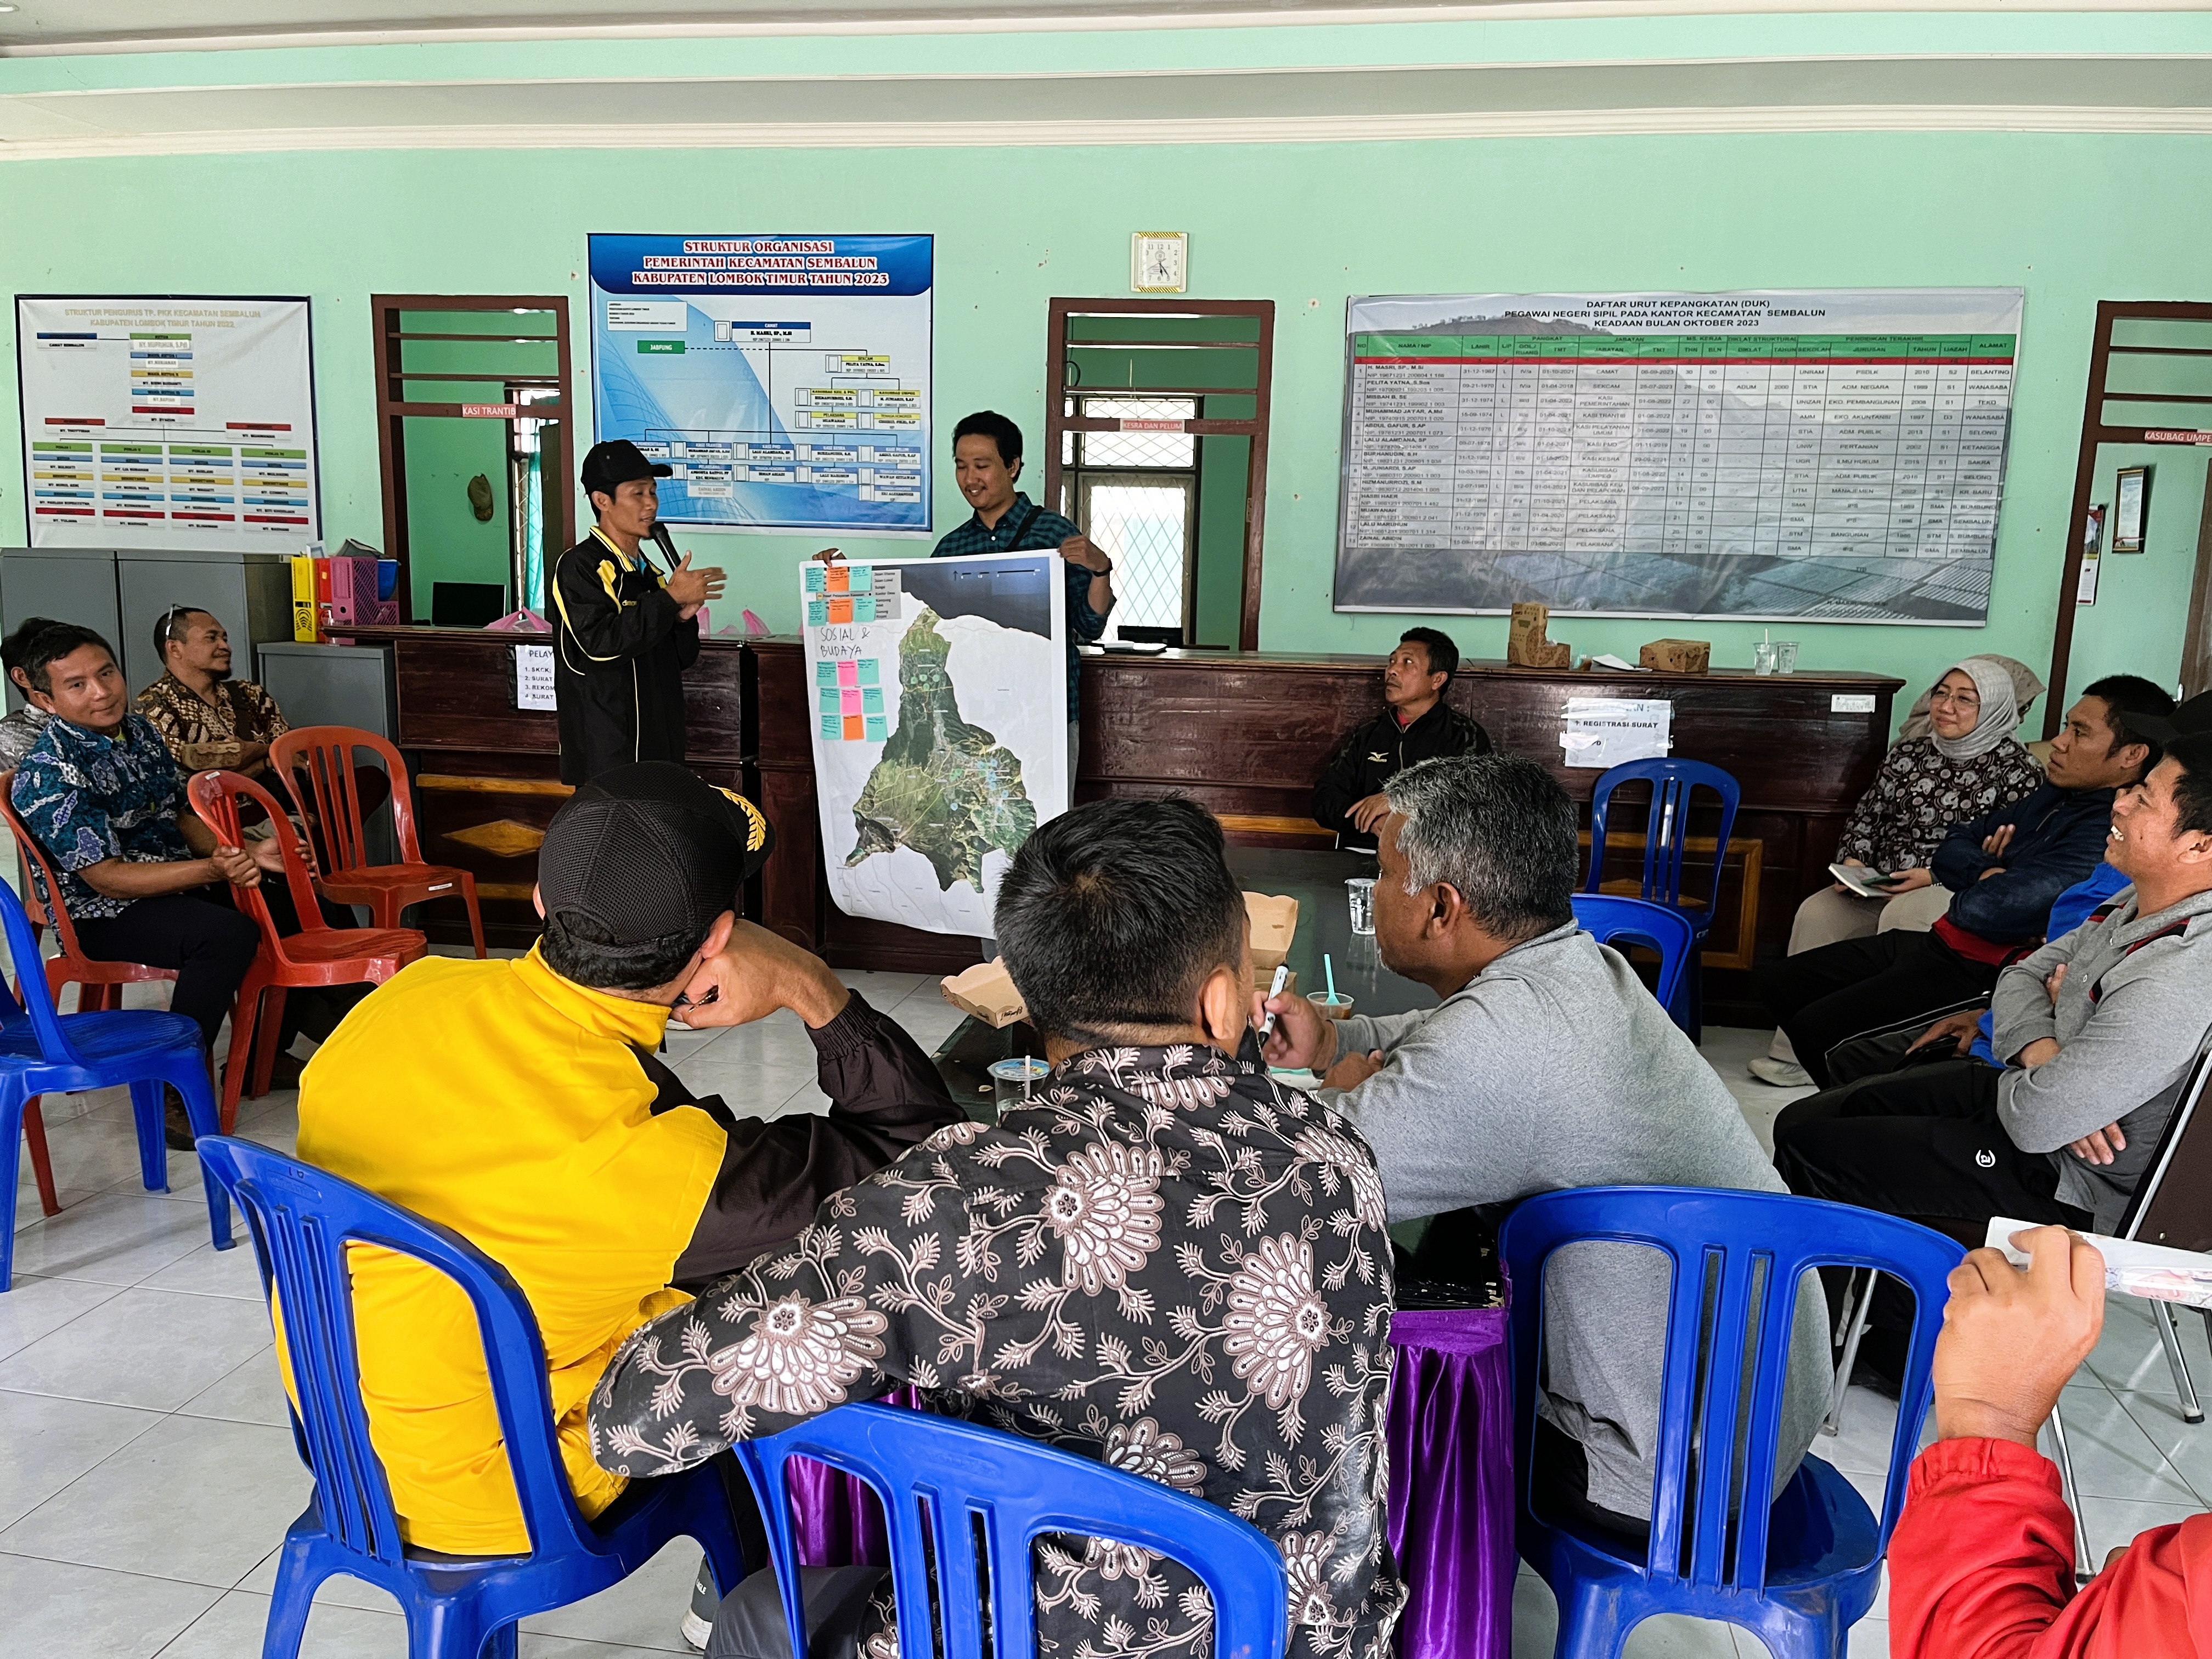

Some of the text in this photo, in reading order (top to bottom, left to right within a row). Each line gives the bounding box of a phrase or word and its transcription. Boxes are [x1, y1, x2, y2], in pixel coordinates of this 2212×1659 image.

[685, 241, 833, 252] STRUKTUR ORGANISASI
[644, 257, 876, 268] PEMERINTAH KECAMATAN SEMBALUN
[633, 273, 888, 285] KABUPATEN LOMBOK TIMUR TAHUN 2023
[462, 407, 516, 415] KASI TRANTIB
[2145, 431, 2184, 441] KASUBAG
[821, 628, 870, 641] SOSIAL &
[821, 645, 862, 658] BUDAYA
